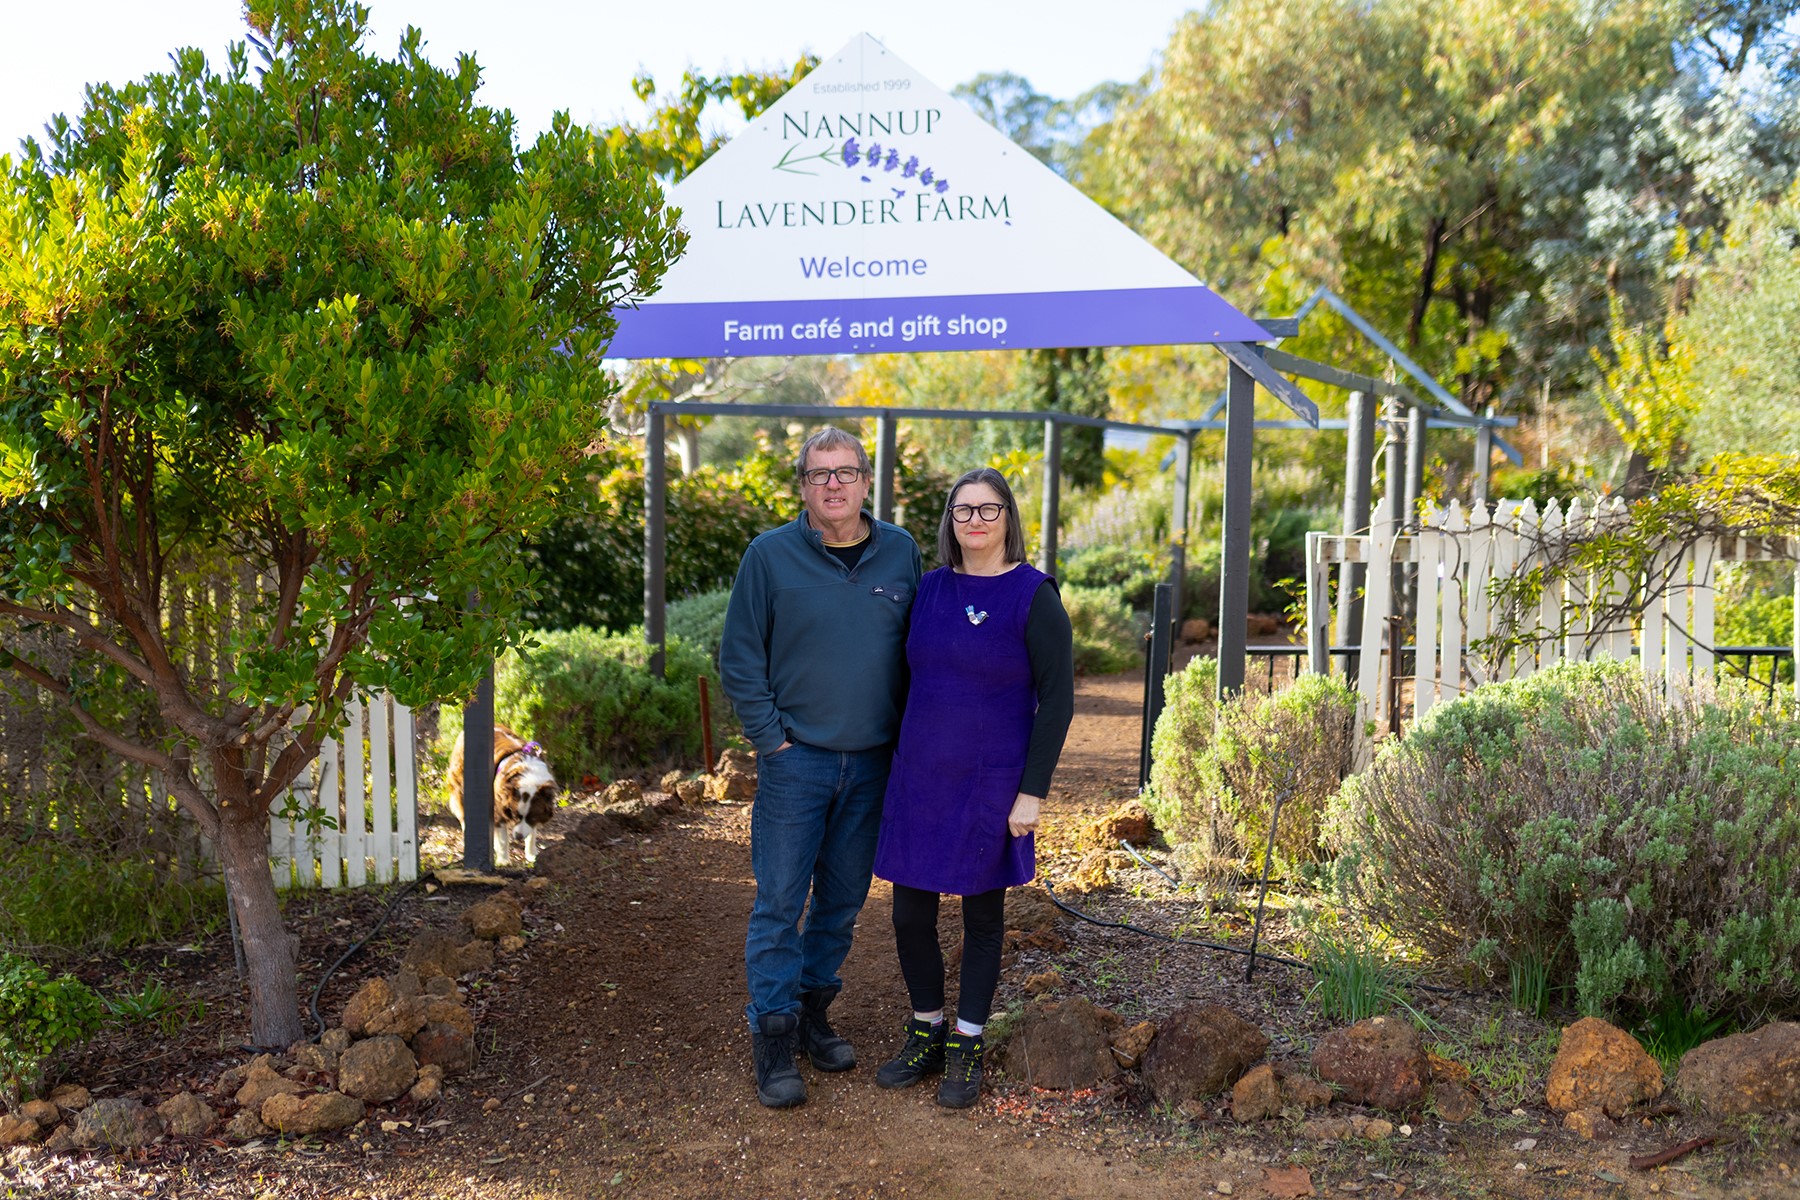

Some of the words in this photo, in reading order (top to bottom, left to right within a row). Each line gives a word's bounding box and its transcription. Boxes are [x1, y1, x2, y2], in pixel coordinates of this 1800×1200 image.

[812, 80, 879, 94] Established
[883, 78, 911, 91] 1999
[783, 108, 941, 139] NANNUP
[716, 198, 901, 229] LAVENDER
[915, 193, 1012, 222] FARM
[800, 256, 928, 279] Welcome
[723, 320, 784, 341] Farm
[791, 317, 842, 340] café
[849, 317, 894, 339] and
[901, 314, 941, 341] gift
[947, 314, 1008, 339] shop
